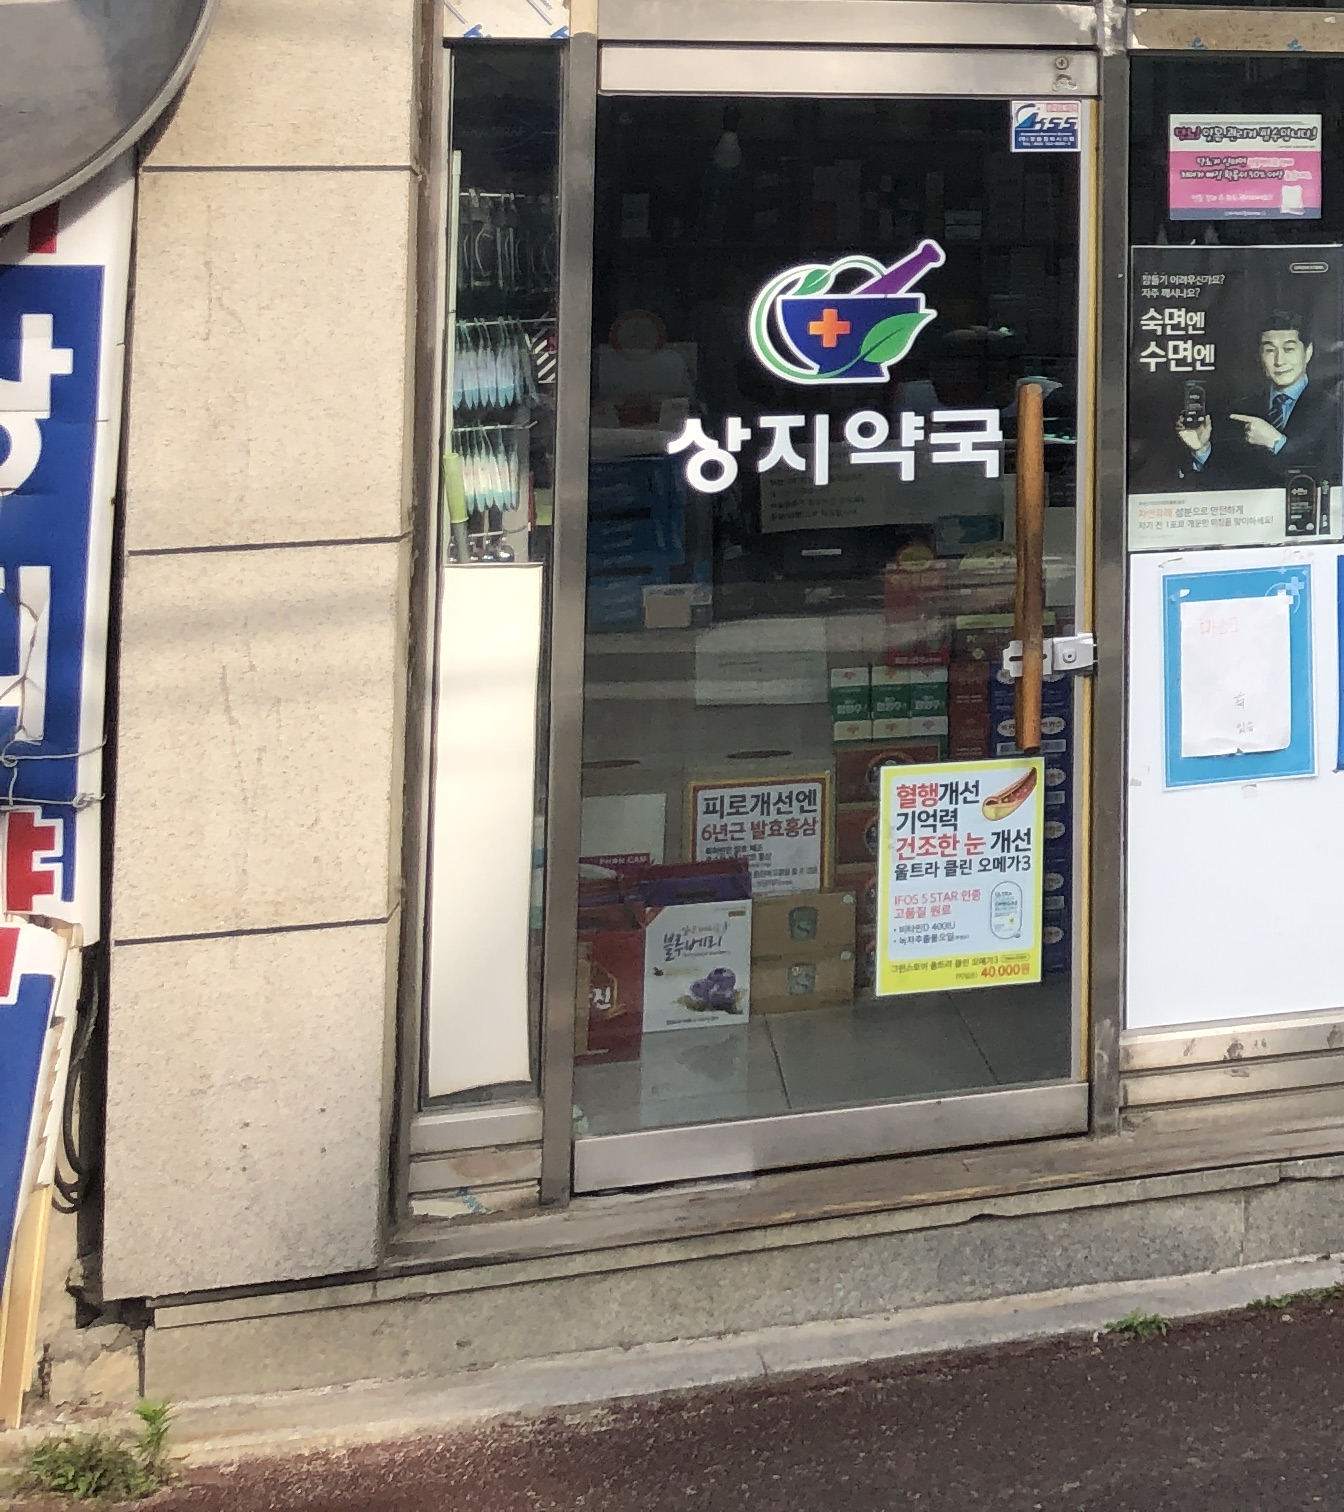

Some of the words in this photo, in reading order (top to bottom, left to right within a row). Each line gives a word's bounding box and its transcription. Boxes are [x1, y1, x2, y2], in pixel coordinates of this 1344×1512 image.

[1259, 127, 1317, 142] 필수입니다!
[1170, 274, 1225, 285] 어려우신가요?
[1141, 289, 1159, 298] 자주
[1140, 308, 1205, 335] 숙면엔
[1139, 340, 1215, 372] 수면엔
[667, 409, 1003, 493] 상지약국
[703, 788, 818, 819] 피로개선엔
[896, 780, 980, 809] 혈행개선
[701, 822, 746, 843] 6년근
[750, 816, 819, 840] 발효홍삼
[896, 808, 958, 834] 기억력
[896, 833, 960, 861] 건조한
[964, 833, 986, 855] 눈
[990, 828, 1032, 853] 개선
[944, 859, 973, 877] 클린
[977, 855, 1031, 873] 오메가3
[894, 894, 919, 905] IFOS
[922, 894, 928, 903] 5
[930, 891, 958, 903] STAR
[960, 889, 981, 902] 인증
[893, 906, 927, 919] 고품질
[930, 905, 951, 918] 원료
[663, 933, 722, 962] 블루베리
